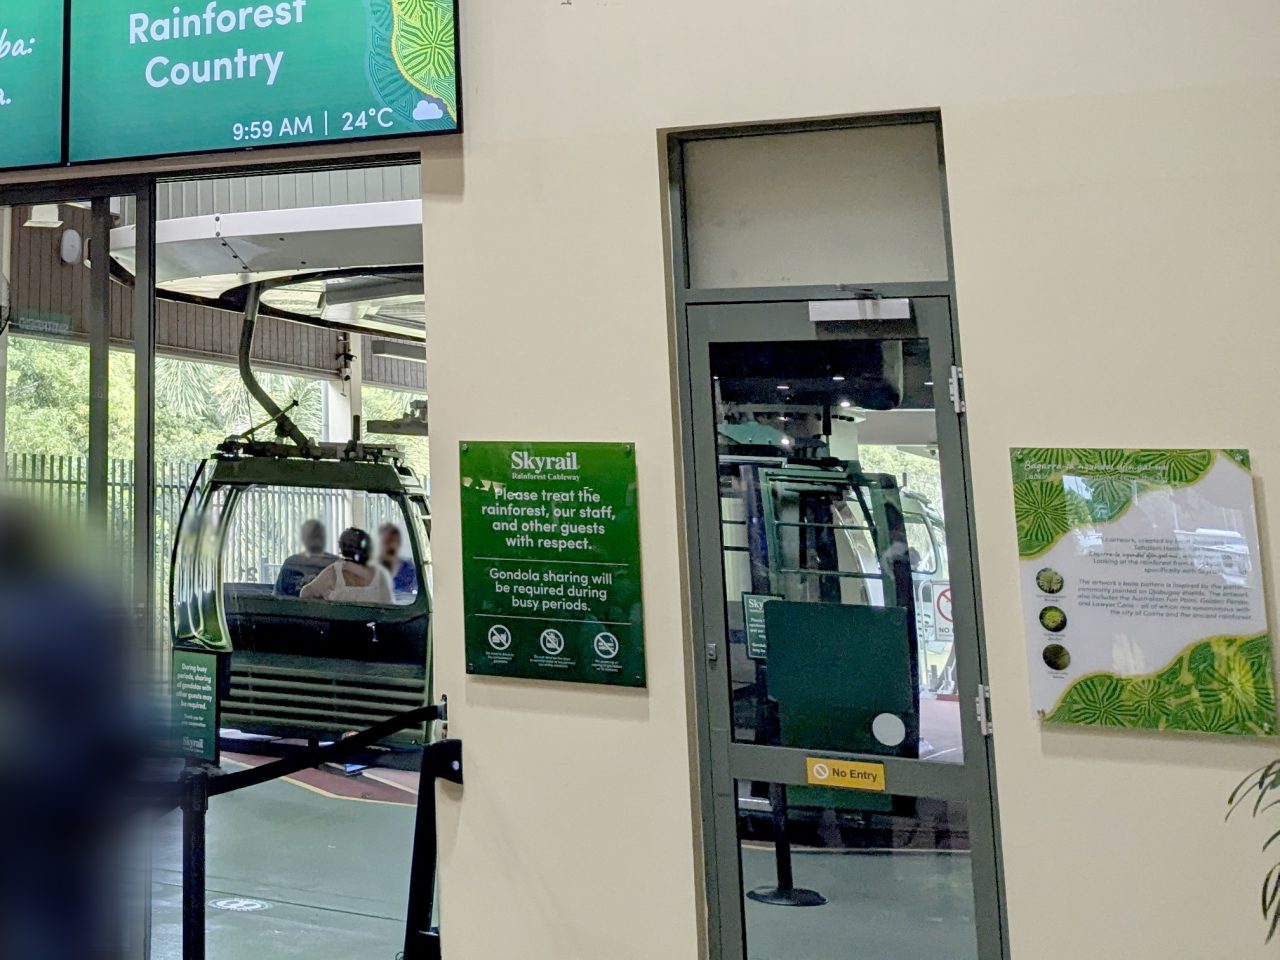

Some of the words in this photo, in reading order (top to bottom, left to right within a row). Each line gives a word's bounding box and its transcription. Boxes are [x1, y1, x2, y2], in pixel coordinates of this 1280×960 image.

[145, 49, 284, 88] Country
[232, 120, 273, 141] 9:59
[279, 116, 313, 136] AM
[342, 107, 393, 131] 24°C
[512, 451, 577, 474] Skyrail
[548, 473, 580, 481] Cableway
[495, 488, 538, 502] Please
[541, 490, 575, 502] treat
[578, 489, 601, 502] the
[482, 504, 549, 519] rainforest,
[553, 508, 577, 518] our
[579, 507, 616, 521] staff,
[493, 520, 518, 531] and
[521, 521, 557, 533] other
[561, 524, 606, 536] guests
[506, 535, 534, 547] with
[538, 538, 593, 552] respect.
[490, 568, 540, 581] Gondola
[543, 571, 589, 586] sharing
[591, 573, 613, 585] will
[495, 582, 510, 593] be
[514, 585, 564, 598] required
[567, 587, 607, 601] during
[512, 597, 540, 610] busy
[542, 599, 591, 612] periods.
[833, 768, 847, 778] No
[850, 770, 877, 782] Entry
